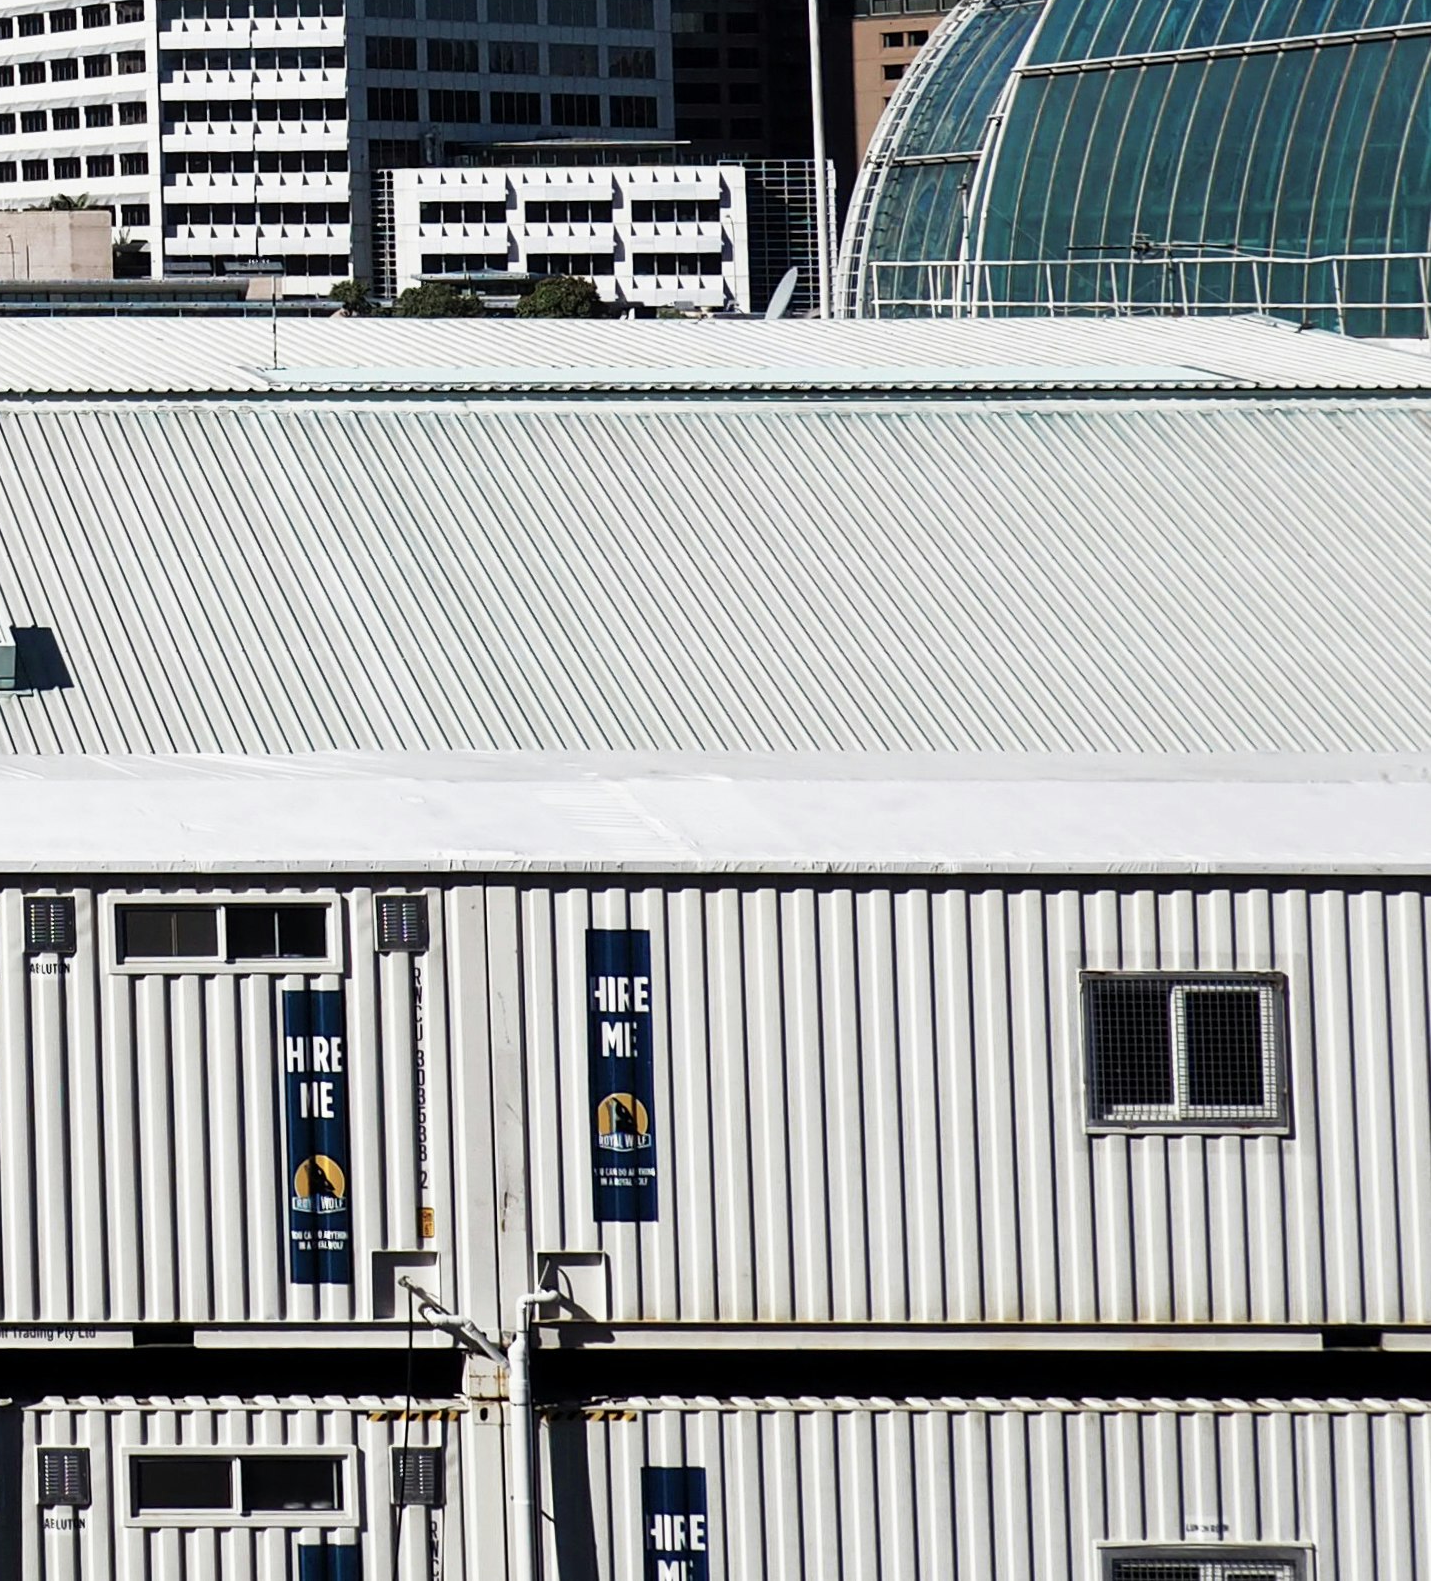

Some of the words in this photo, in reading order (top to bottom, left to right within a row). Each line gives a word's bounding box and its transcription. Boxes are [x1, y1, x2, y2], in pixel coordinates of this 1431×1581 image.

[590, 976, 650, 1013] HIRE
[12, 1327, 53, 1341] Trading
[57, 1327, 74, 1340] Pty
[78, 1327, 96, 1338] Ltd
[646, 1514, 706, 1551] HIRE
